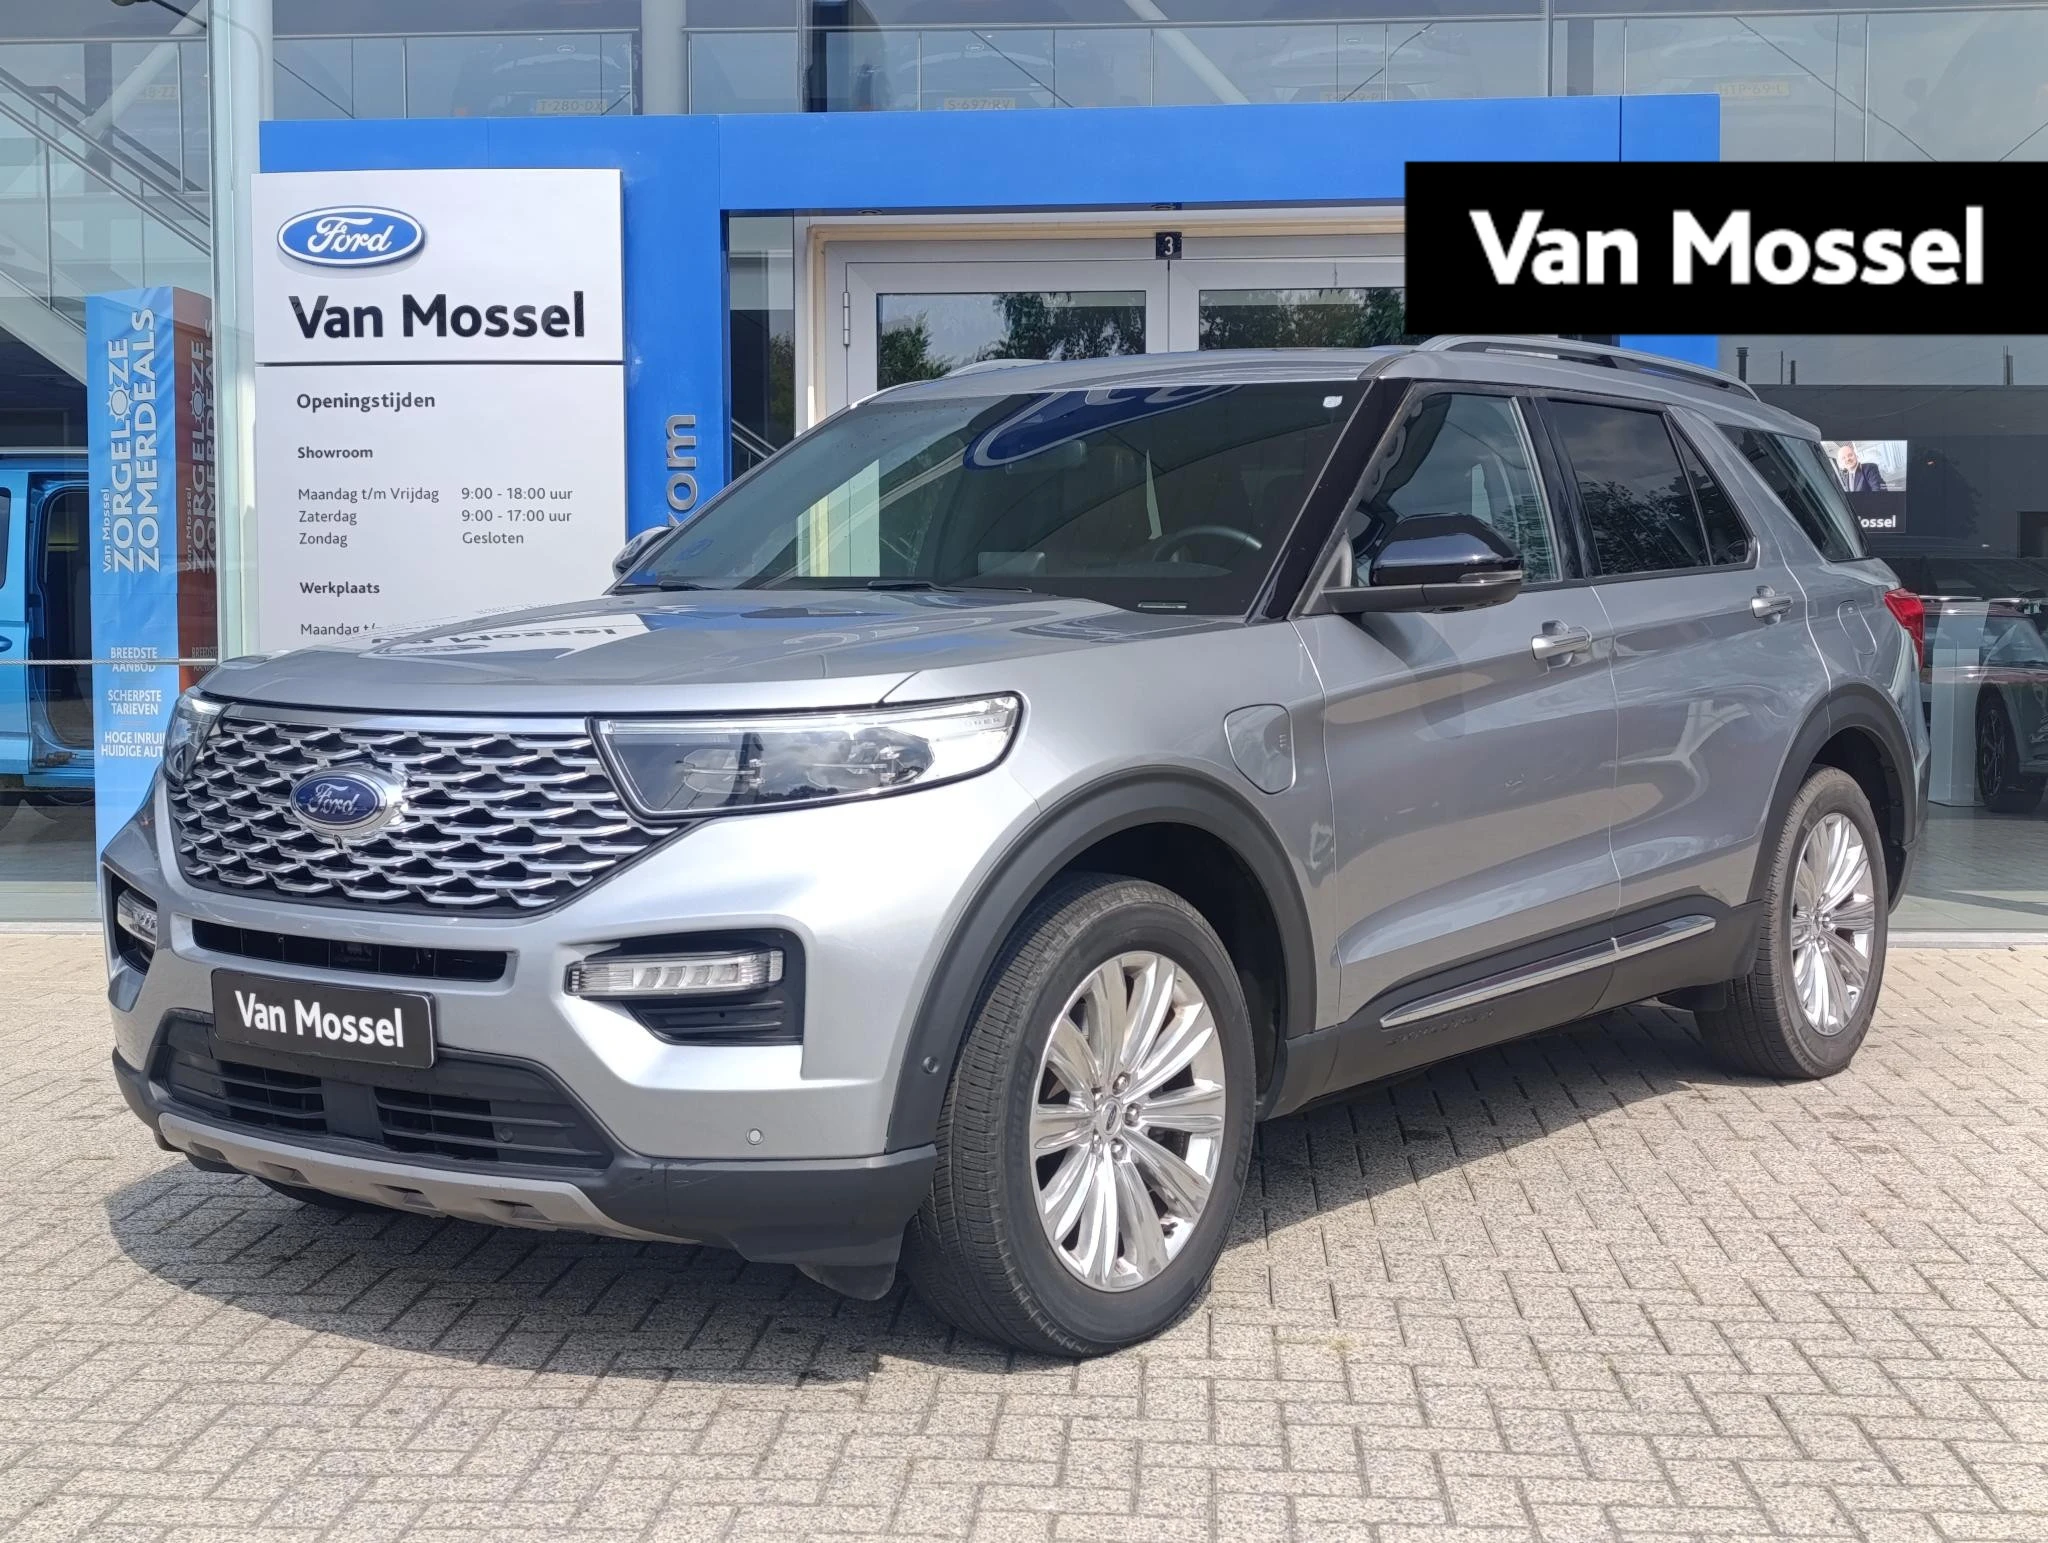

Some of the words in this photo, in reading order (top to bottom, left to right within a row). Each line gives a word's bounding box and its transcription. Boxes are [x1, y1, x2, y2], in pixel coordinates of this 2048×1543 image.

[307, 216, 394, 253] Ford
[1164, 236, 1174, 256] 3
[288, 295, 384, 338] Van
[402, 290, 585, 338] Mossel
[296, 391, 436, 413] Openingstijden
[132, 308, 160, 573] ZOMERDEALS
[297, 446, 374, 459] Showroom
[298, 487, 358, 503] Maandag
[361, 487, 387, 501] t/m
[390, 487, 440, 503] Vrijdag
[461, 487, 493, 500] 9:00
[506, 487, 546, 500] 18:00
[549, 490, 573, 500] uur
[101, 488, 111, 541] Mossel
[298, 510, 358, 526] Zaterdag
[461, 509, 493, 522] 9:00
[506, 509, 545, 522] 17:00
[548, 512, 572, 522] uur
[1857, 514, 1897, 528] ossel
[298, 532, 348, 548] Zondag
[462, 531, 524, 544] Gesloten
[103, 542, 112, 573] Van
[299, 581, 380, 598] Werkplaats
[110, 647, 158, 659] BREEDSTE
[112, 663, 156, 673] AANBOD
[107, 689, 162, 702] SCHERPSTE
[111, 703, 159, 715] TARIEVEN
[104, 731, 133, 744] HOGE
[101, 745, 142, 757] HUIDIGE
[306, 782, 361, 816] Ford
[234, 990, 288, 1034] Van
[294, 998, 404, 1048] Mossel
